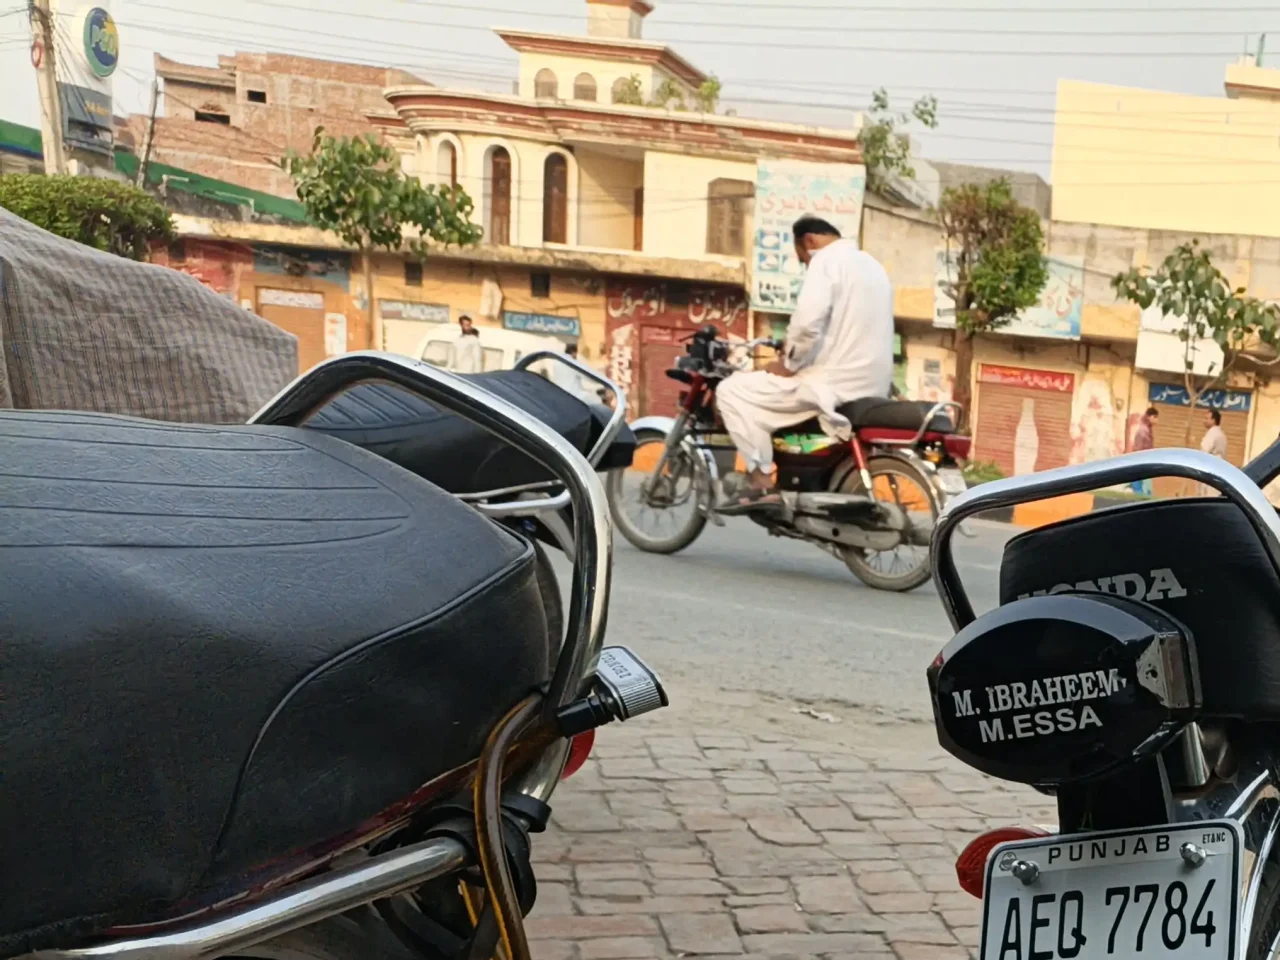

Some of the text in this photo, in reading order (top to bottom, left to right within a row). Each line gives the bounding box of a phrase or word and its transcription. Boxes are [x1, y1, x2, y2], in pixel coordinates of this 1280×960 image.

[978, 705, 1104, 743] M.ESSA
[1048, 834, 1170, 864] PUNJAB
[1105, 878, 1217, 955] 7784
